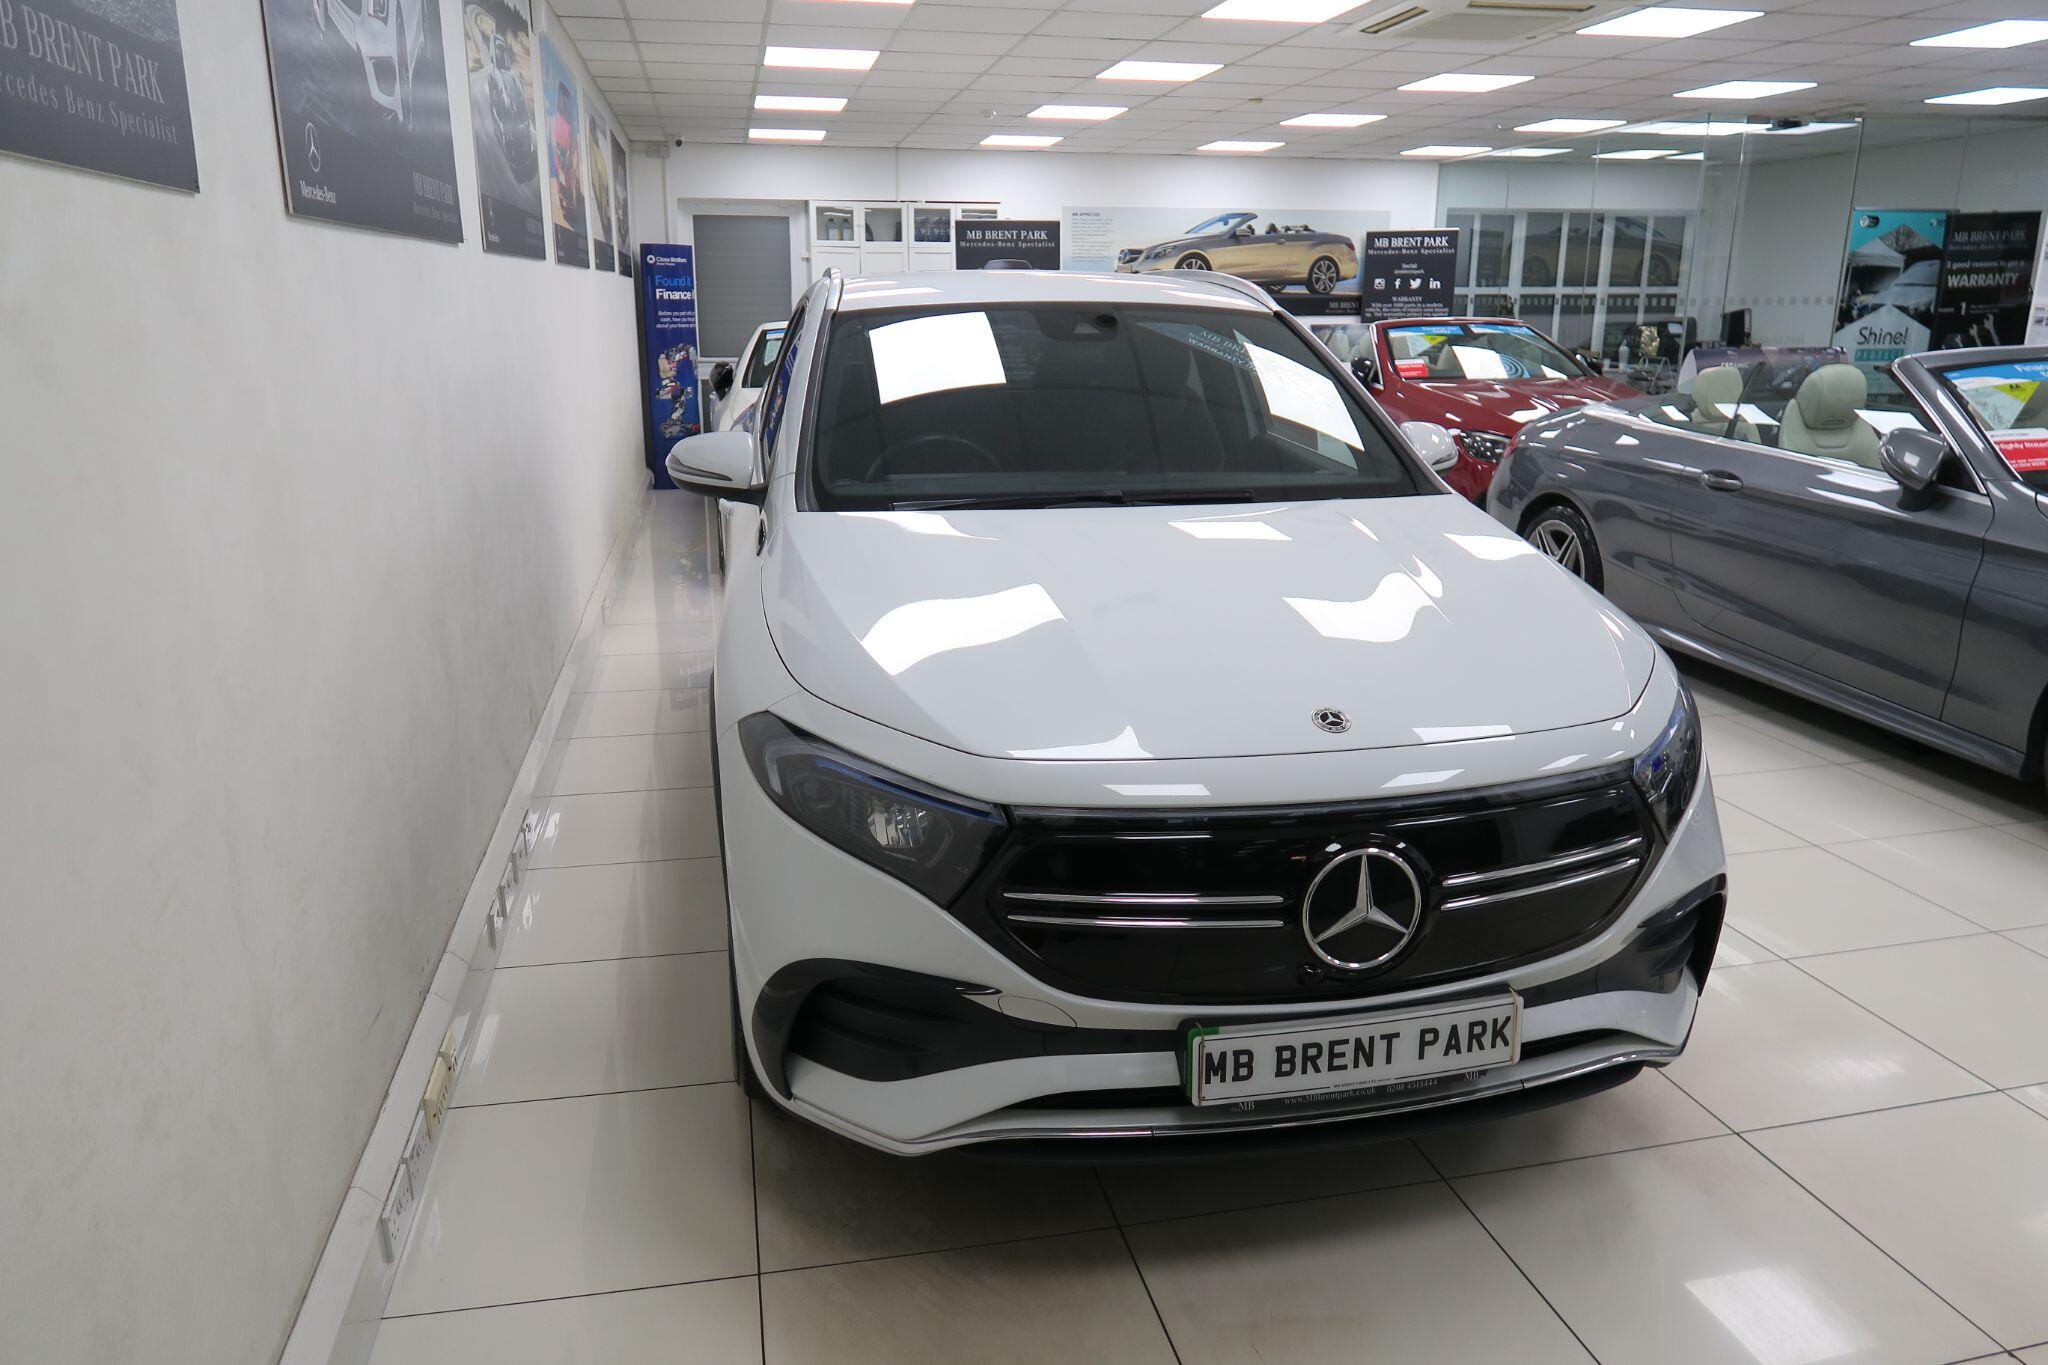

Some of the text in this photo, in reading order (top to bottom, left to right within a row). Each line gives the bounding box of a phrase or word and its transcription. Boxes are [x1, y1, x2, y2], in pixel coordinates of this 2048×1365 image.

[22, 5, 104, 82] BRENT
[107, 41, 165, 104] PARK
[65, 85, 104, 123] Benz
[109, 101, 178, 144] Specialist
[966, 230, 1048, 240] MB BRENT PARK
[1953, 230, 2026, 241] MB BRENT PARK
[1374, 236, 1449, 248] MB BRENT PARK
[656, 275, 686, 286] Found
[1947, 272, 2019, 288] WARRANTY
[656, 288, 692, 300] Finance
[1857, 326, 1909, 345] Shine!
[1205, 1016, 1511, 1084] MB BRENT PARK
[1238, 1101, 1255, 1111] MB
